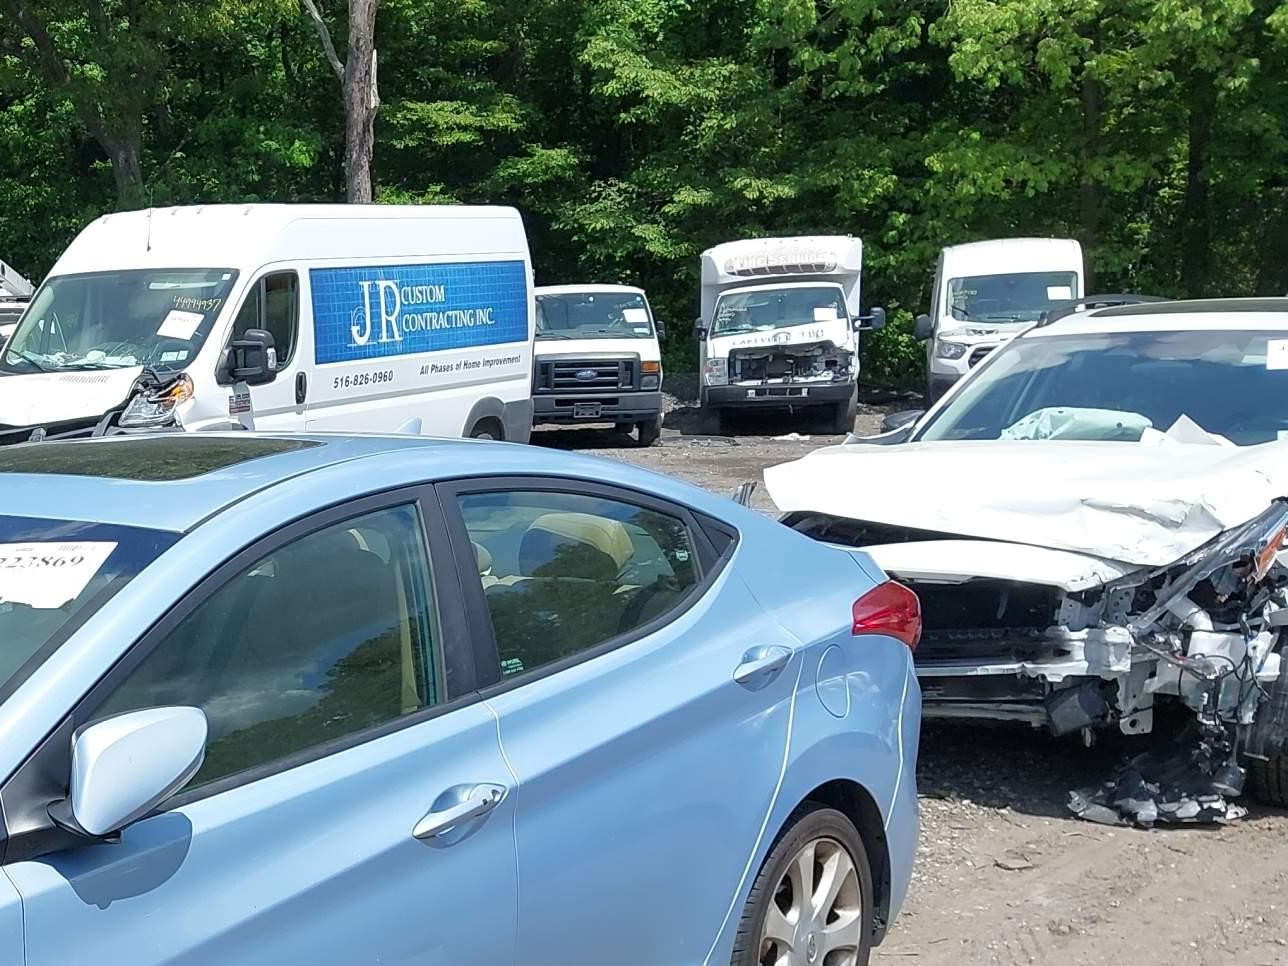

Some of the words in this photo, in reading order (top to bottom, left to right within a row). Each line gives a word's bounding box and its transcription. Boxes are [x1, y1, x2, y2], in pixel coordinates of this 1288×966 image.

[401, 285, 445, 304] CUSTOM
[351, 279, 403, 345] JR
[402, 309, 474, 331] CONTRACTING
[419, 365, 429, 375] All
[430, 363, 454, 374] Phases
[455, 362, 462, 371] of
[463, 360, 481, 369] Home
[482, 354, 521, 369] Improvement
[333, 370, 394, 388] 516-826-0960
